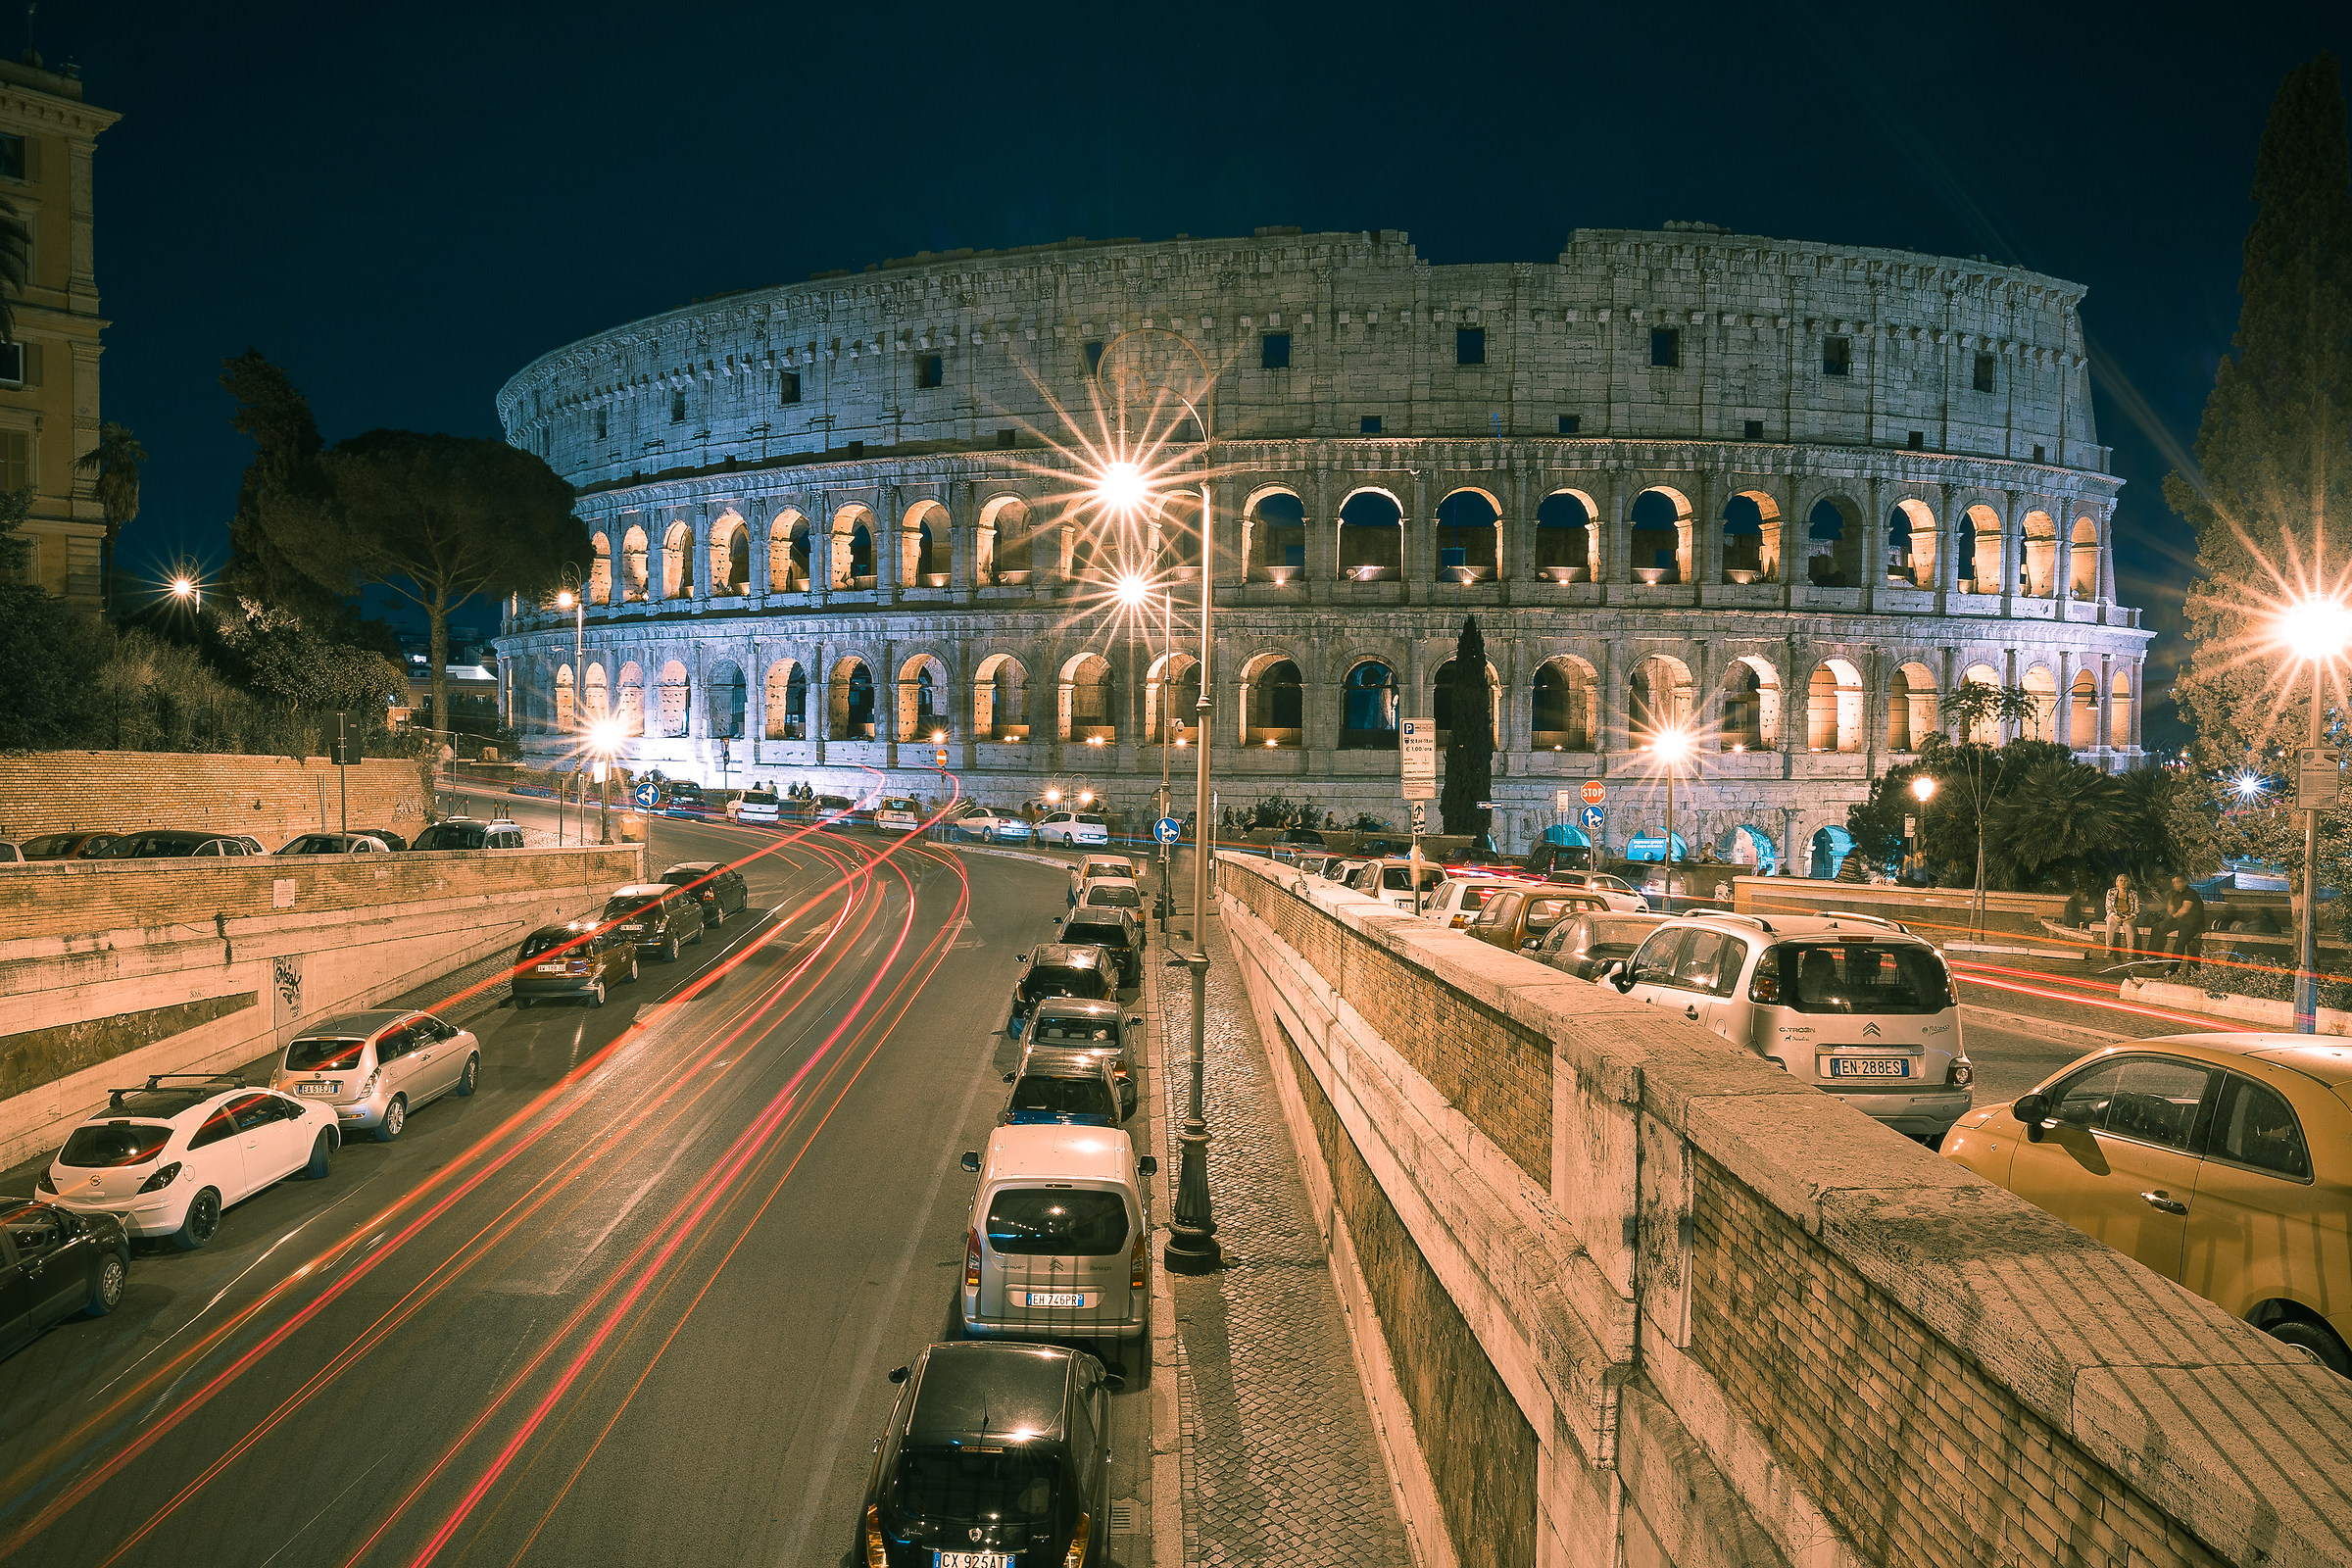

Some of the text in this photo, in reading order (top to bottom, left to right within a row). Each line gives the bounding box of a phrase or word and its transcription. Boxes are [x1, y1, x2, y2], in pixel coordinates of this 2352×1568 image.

[1405, 724, 1412, 733] P
[1582, 788, 1603, 798] STOP
[1033, 1295, 1045, 1304] EH
[1048, 1296, 1077, 1305] 746PR
[942, 1554, 958, 1568] CX
[964, 1555, 1006, 1568] 925AT
